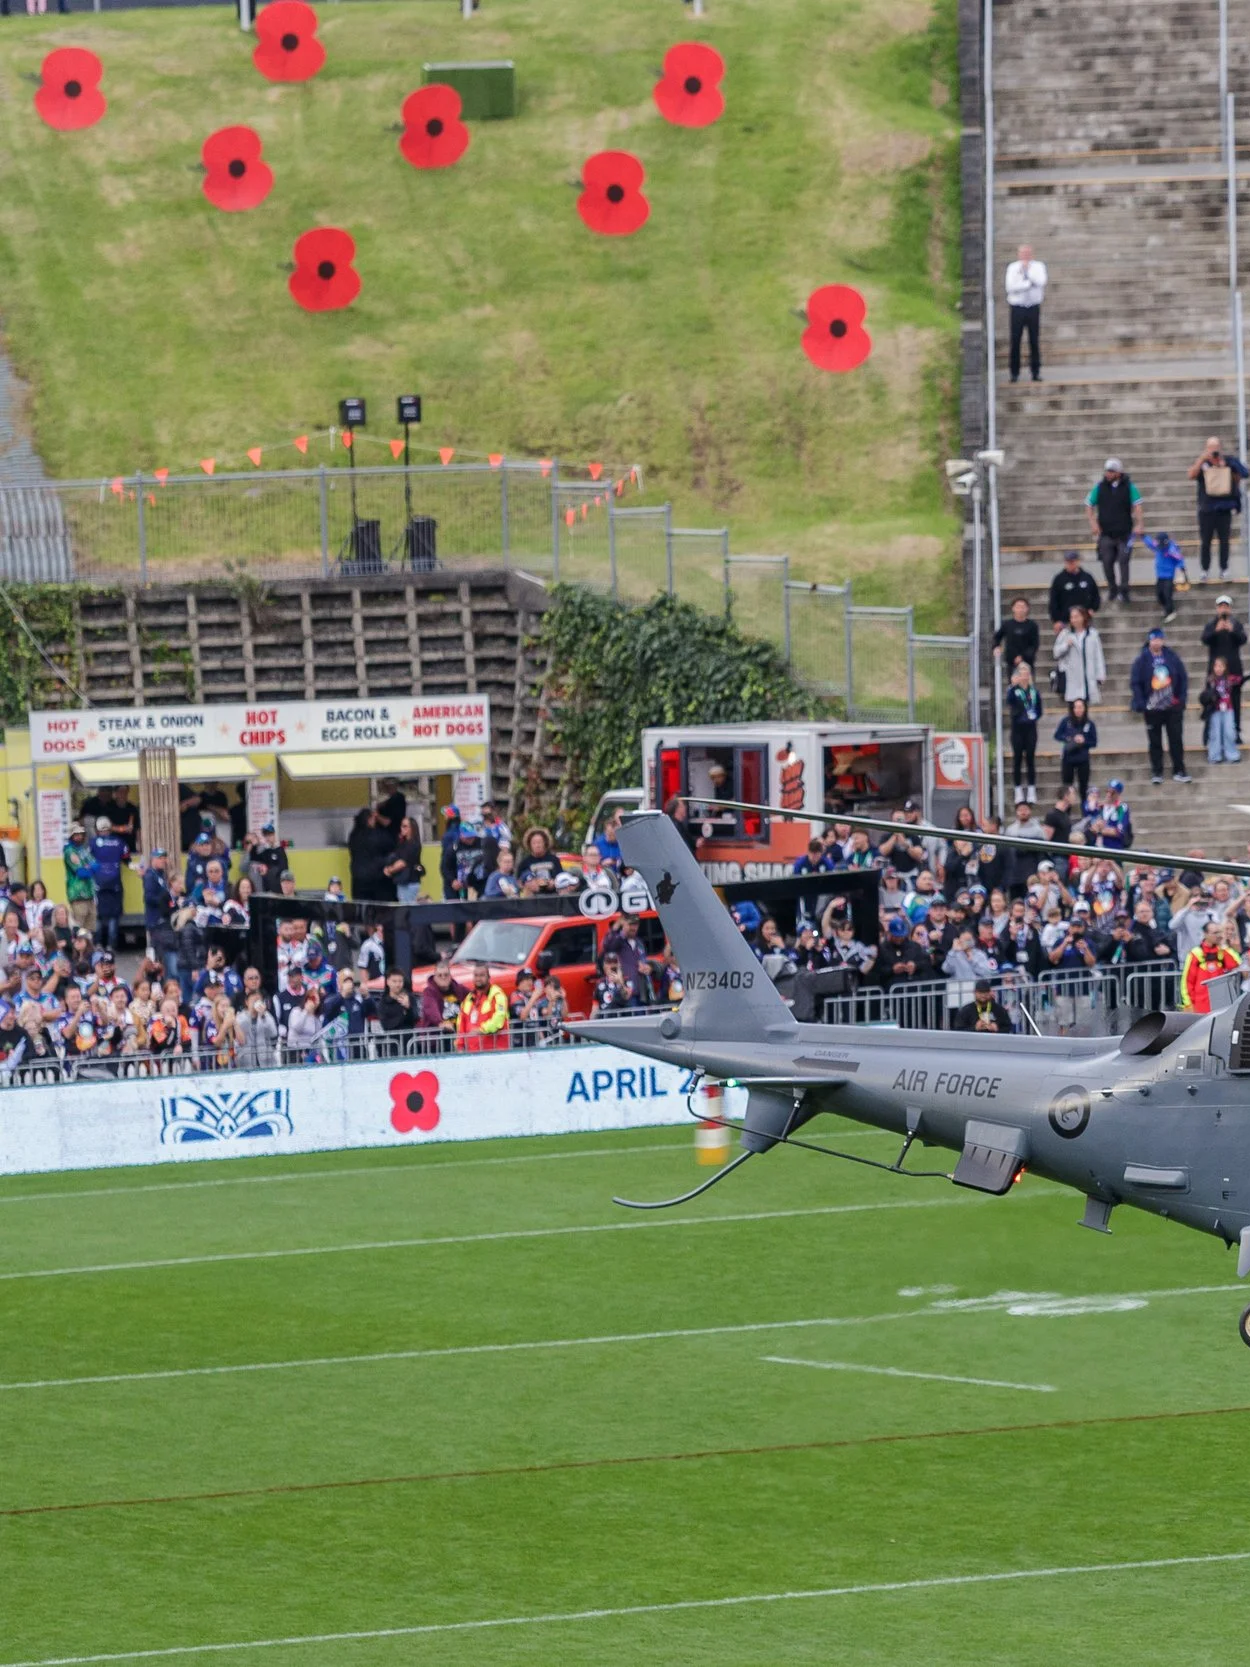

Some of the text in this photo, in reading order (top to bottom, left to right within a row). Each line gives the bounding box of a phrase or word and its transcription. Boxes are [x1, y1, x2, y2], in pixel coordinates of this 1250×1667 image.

[246, 709, 278, 726] HOT
[326, 707, 389, 723] BACON &
[413, 705, 484, 721] AMERICAN
[47, 719, 79, 734] HOT
[98, 713, 204, 731] STEAK & ONION
[413, 721, 484, 738] HOT DOGS
[108, 733, 197, 751] SANDWICHES
[239, 729, 287, 747] CHIPS
[321, 725, 398, 742] EGG ROLLS
[43, 738, 86, 753] DOGS
[686, 971, 754, 990] NZ3403
[566, 1066, 668, 1103] APRIL
[892, 1069, 1002, 1098] AIR FORCE
